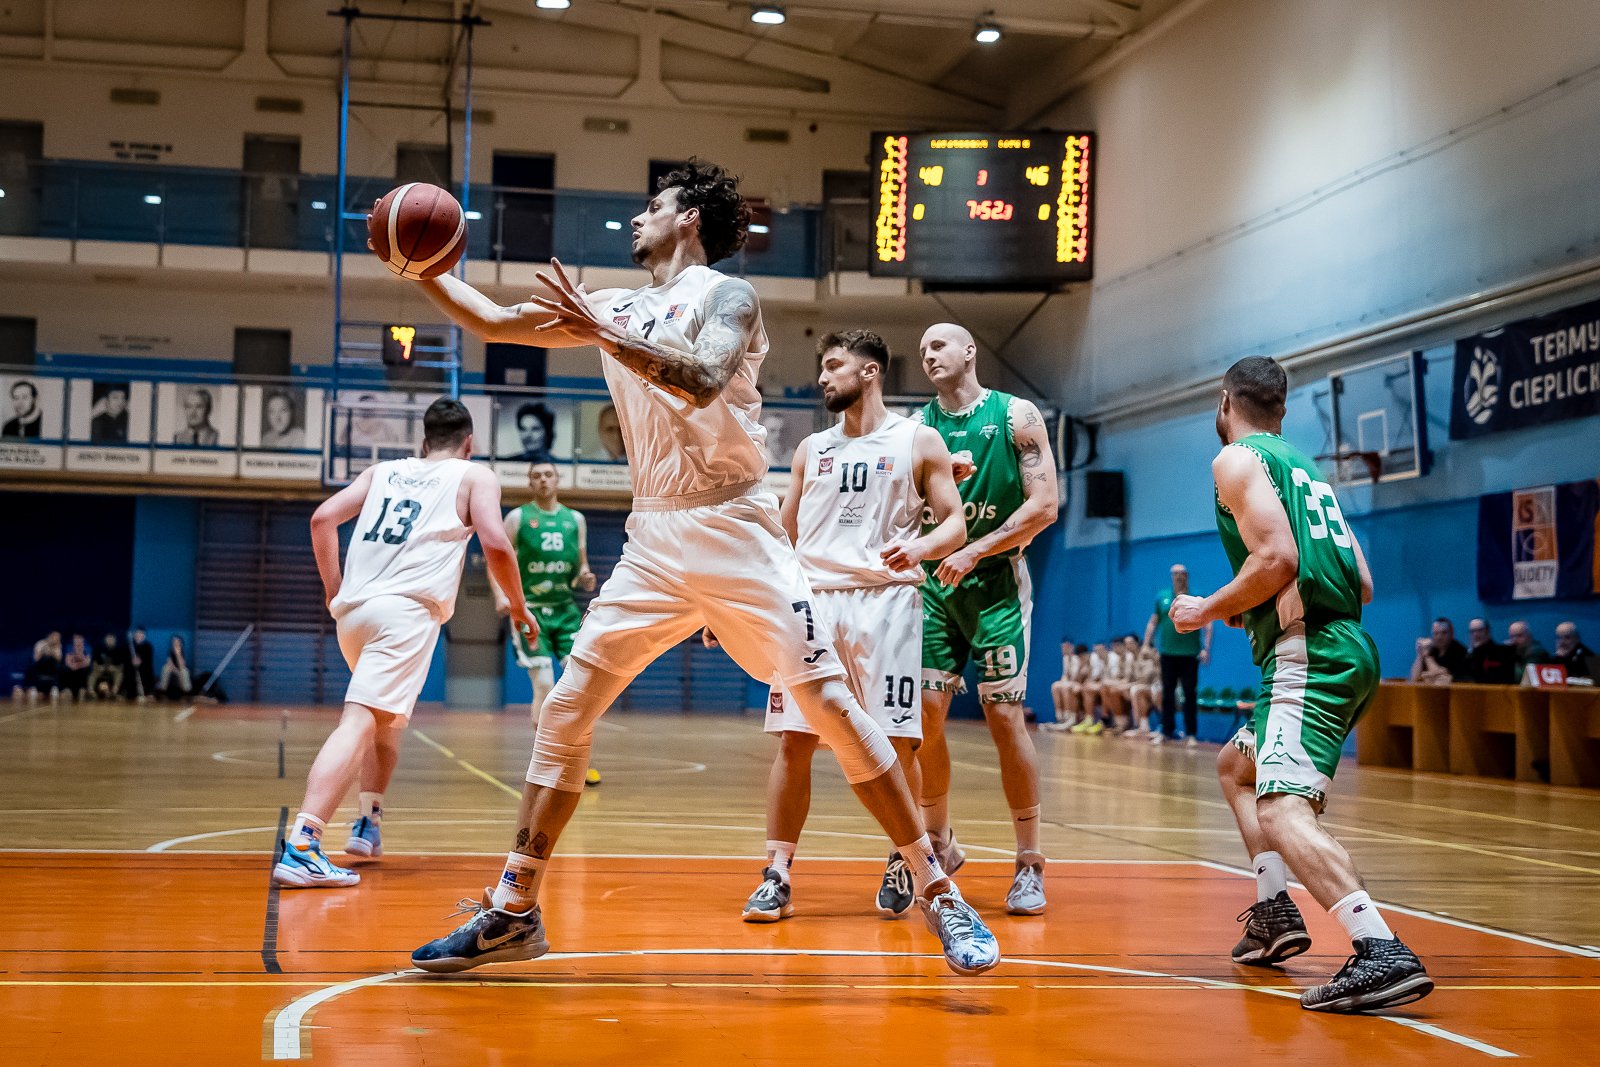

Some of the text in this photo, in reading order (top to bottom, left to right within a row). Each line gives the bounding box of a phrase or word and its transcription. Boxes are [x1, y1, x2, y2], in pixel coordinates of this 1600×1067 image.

[641, 318, 656, 341] 7
[1530, 320, 1600, 365] TERMY
[839, 462, 868, 494] 10
[362, 497, 422, 545] 13
[1290, 467, 1353, 549] 33
[541, 531, 565, 552] 26
[791, 600, 815, 642] 7
[984, 644, 1019, 677] 19
[884, 674, 915, 709] 10
[502, 879, 530, 891] SUDETY
